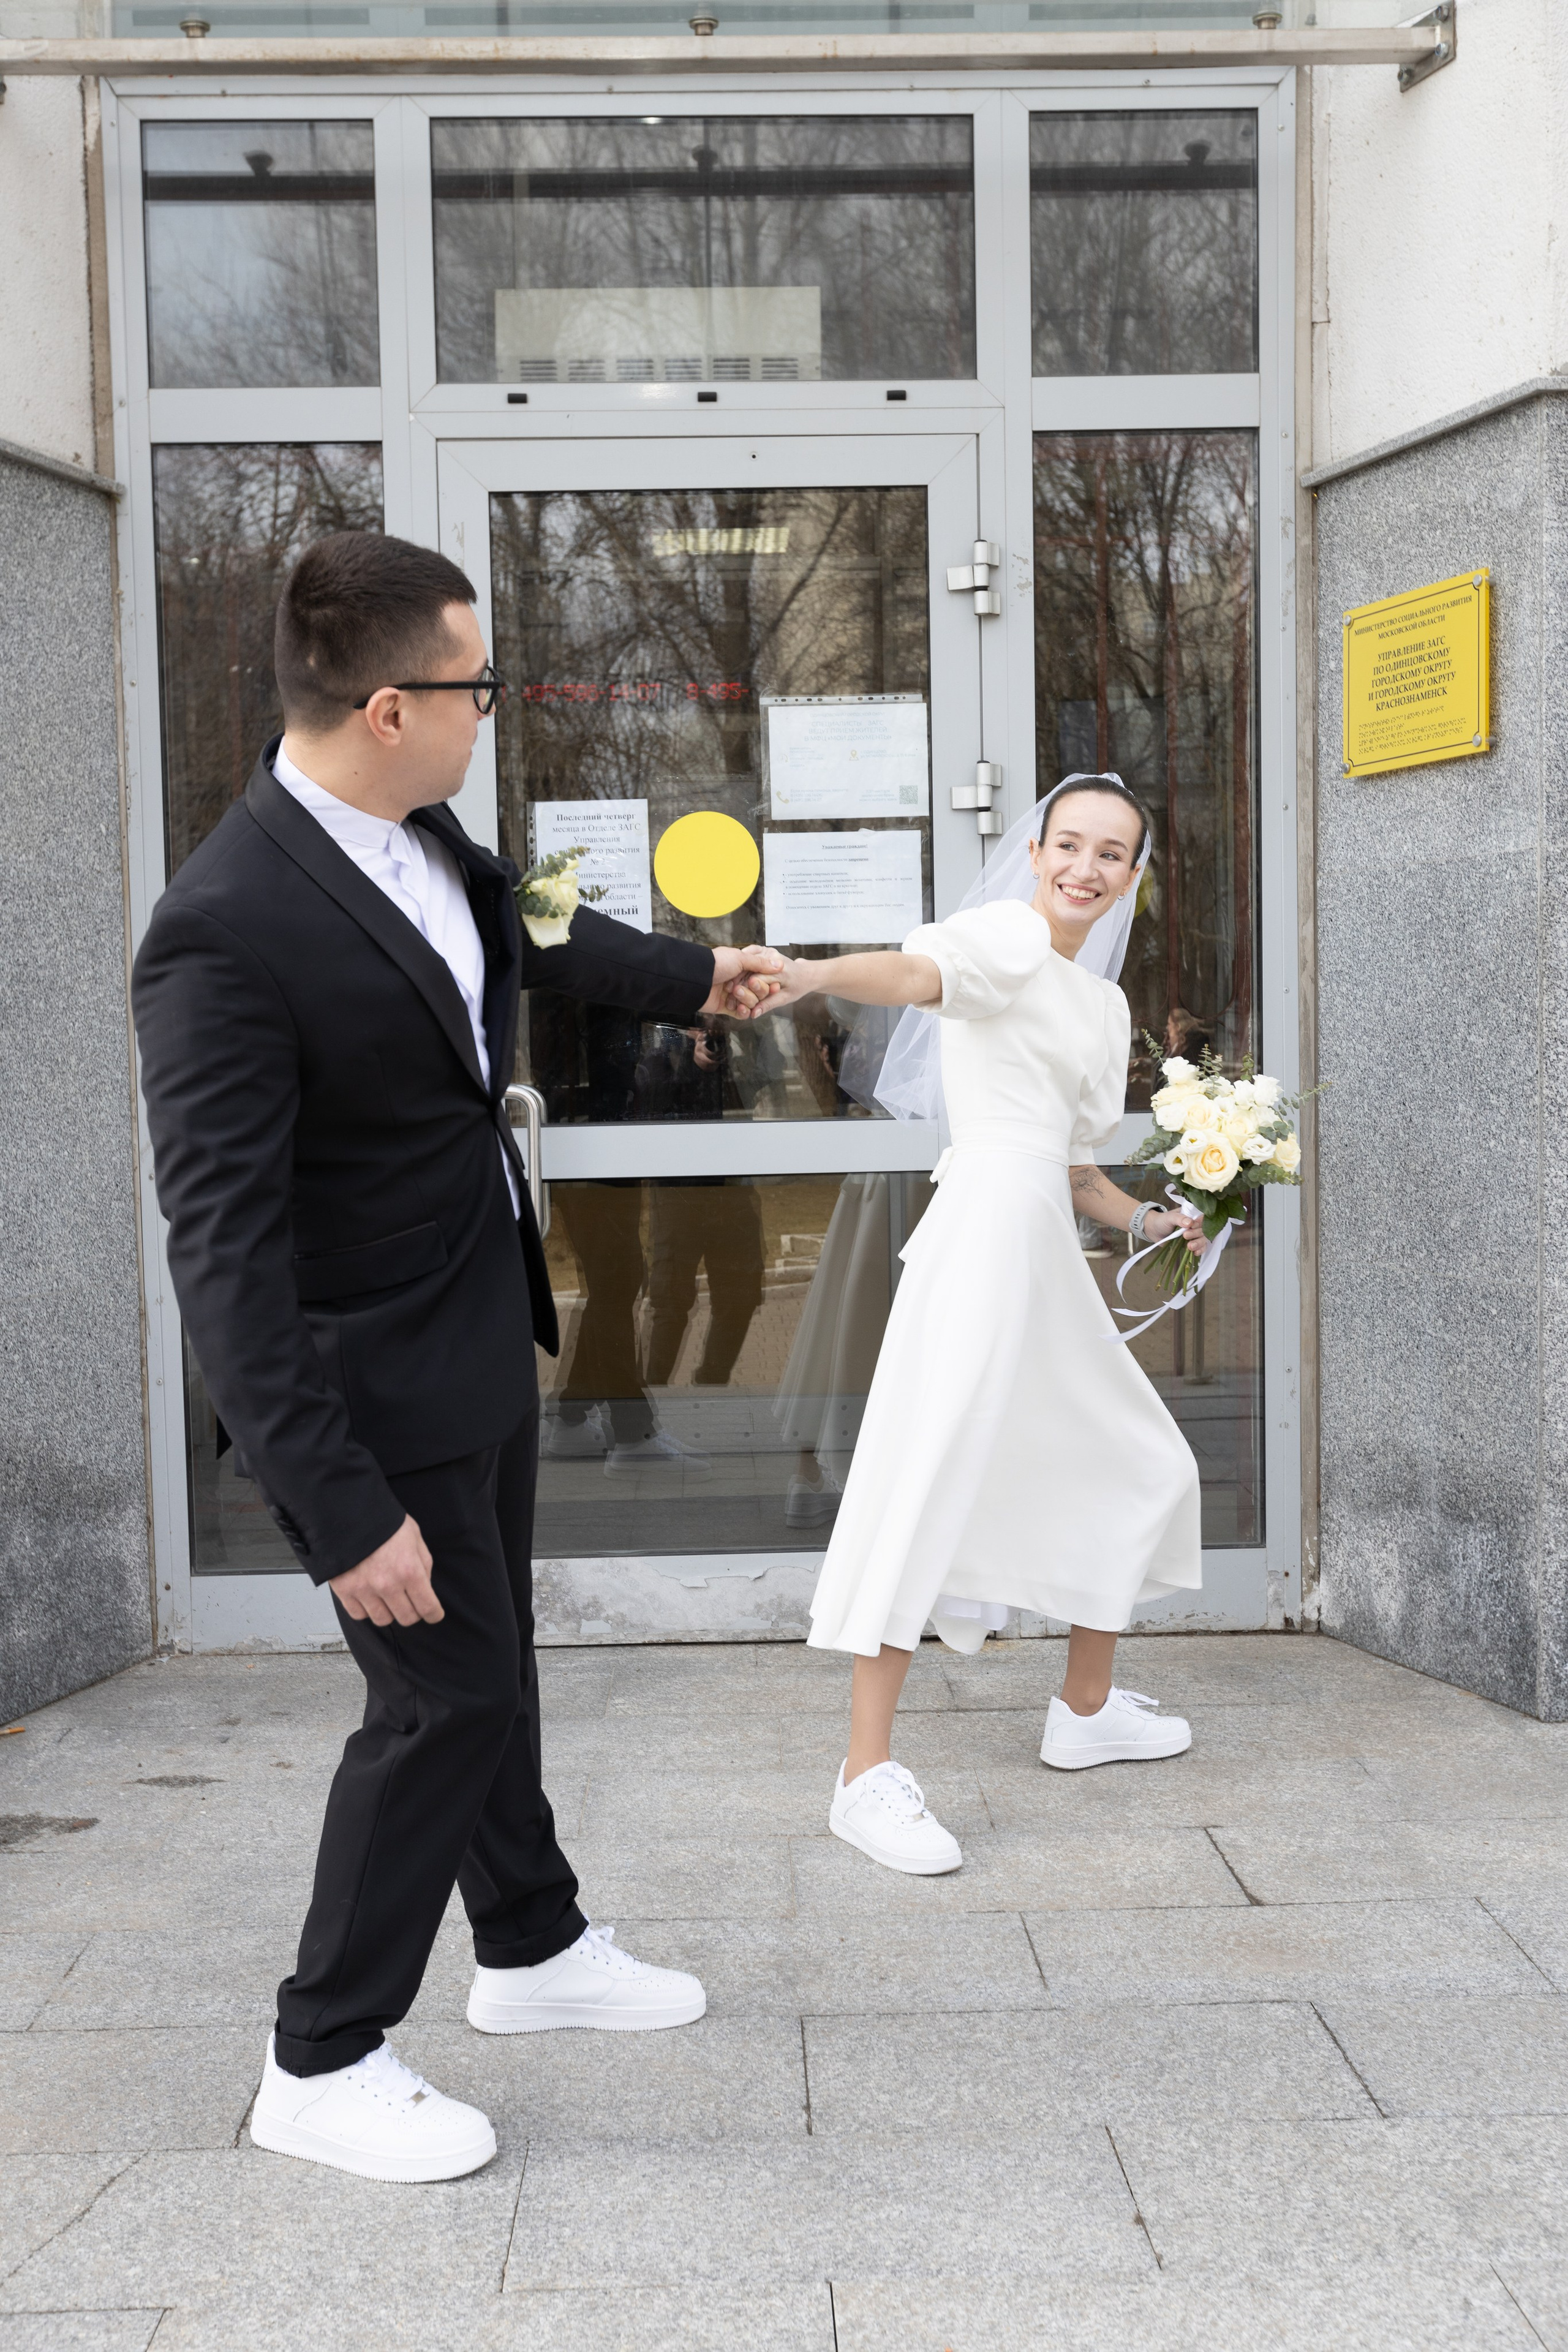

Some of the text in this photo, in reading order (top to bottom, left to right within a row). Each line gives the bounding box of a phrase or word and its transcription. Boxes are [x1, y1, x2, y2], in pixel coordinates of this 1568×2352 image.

[1354, 595, 1472, 636] МИНИСТЕРСТВО СОЦИАЛЬНОГО РАЗВИТИЯ
[1378, 614, 1446, 639] МОСКОВСКОЙ ОБЛАСТИ
[1373, 647, 1450, 676] ПО ОДИНЦОВСКОМУ
[1378, 635, 1446, 662] УПРАВЛЕНИЕ ЗАГС
[1368, 671, 1457, 701] И ГОРОДСКОМУ ОКРУГУ
[1372, 659, 1453, 688] ГОРОДСКОМУ ОКРУГУ
[1376, 686, 1448, 711] КРАСНОЗНАМЕНСК
[605, 813, 636, 822] четверг
[574, 836, 620, 845] Управления
[606, 847, 640, 856] развития
